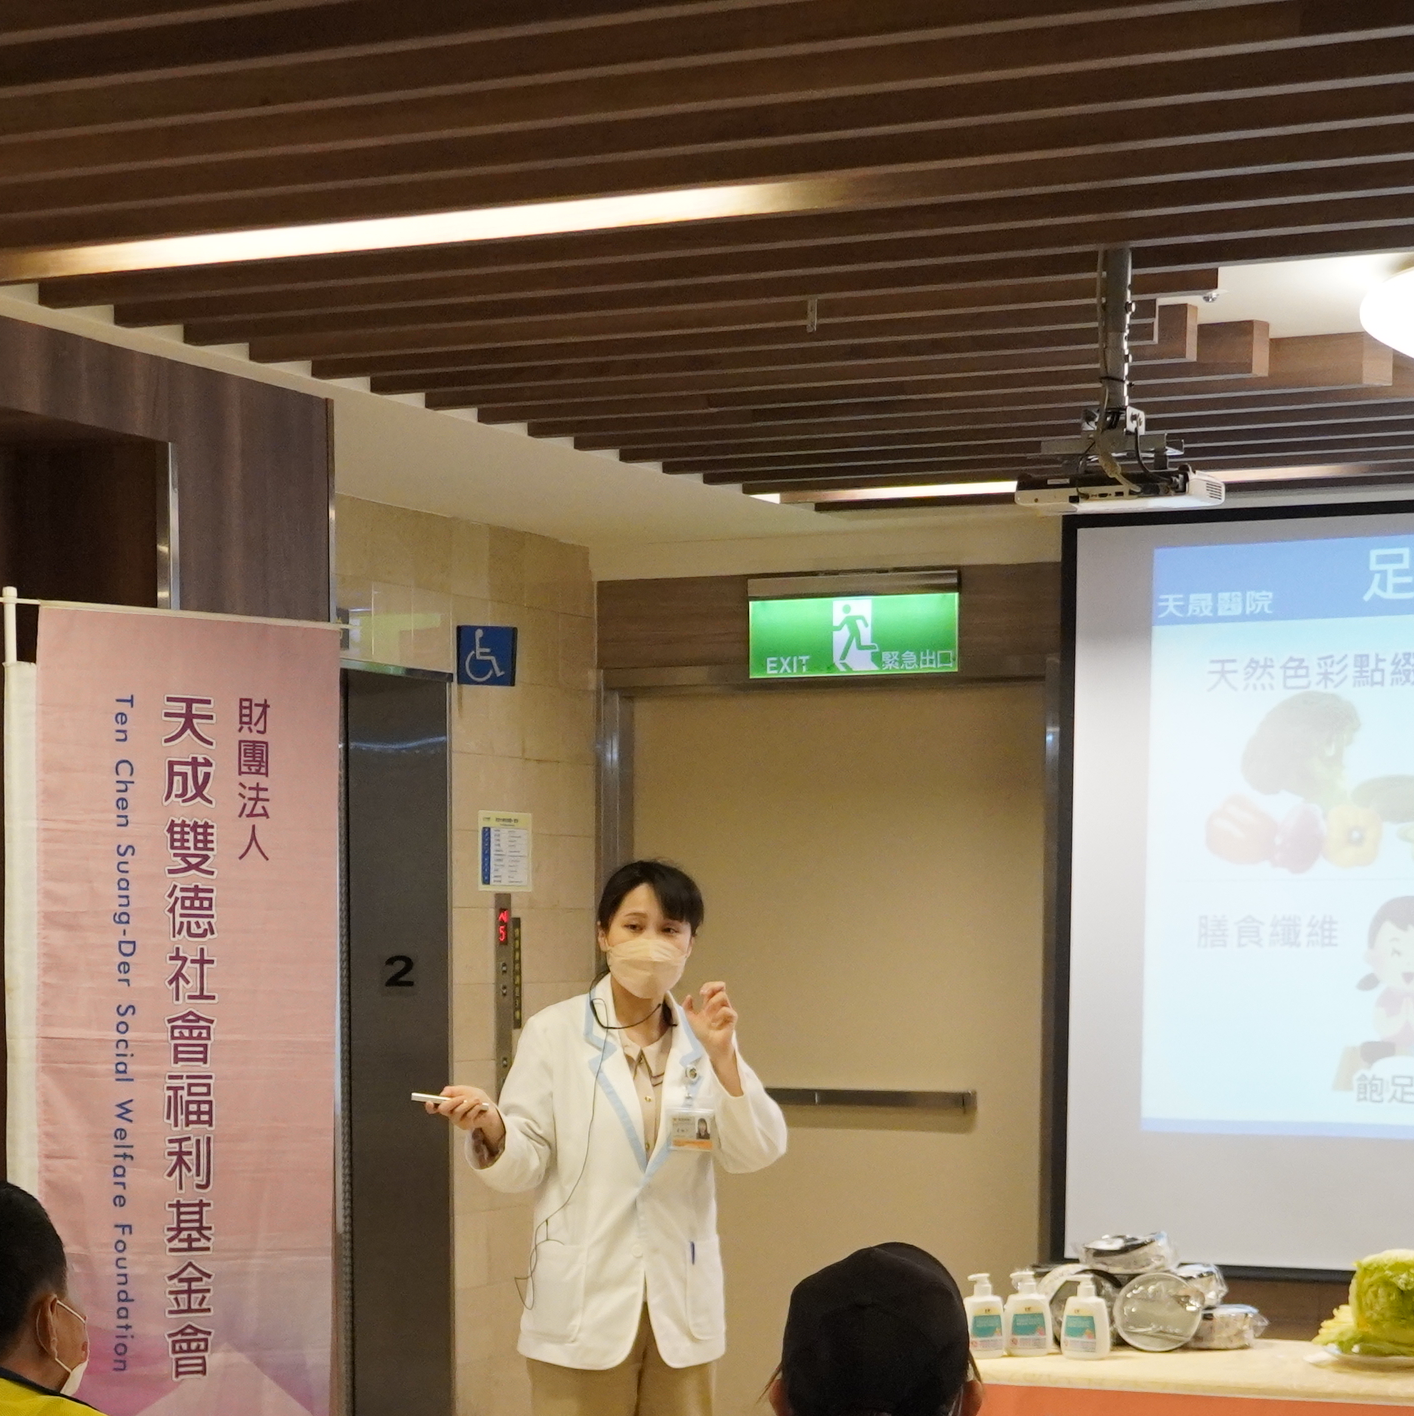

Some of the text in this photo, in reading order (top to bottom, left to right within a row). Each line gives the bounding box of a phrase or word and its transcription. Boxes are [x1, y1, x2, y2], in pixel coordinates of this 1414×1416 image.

[1157, 590, 1275, 620] 天晟醫院
[766, 655, 810, 674] EXIT
[882, 649, 953, 670] 緊急出口
[237, 697, 270, 861] 財團法人
[498, 925, 506, 942] 5
[1197, 914, 1339, 950] 膳食纖維
[384, 955, 415, 987] 2
[113, 694, 136, 1372] Ten Chen Suang-Der Social Welfare Foundation
[162, 695, 217, 1379] 天成雙德社會福利基金會
